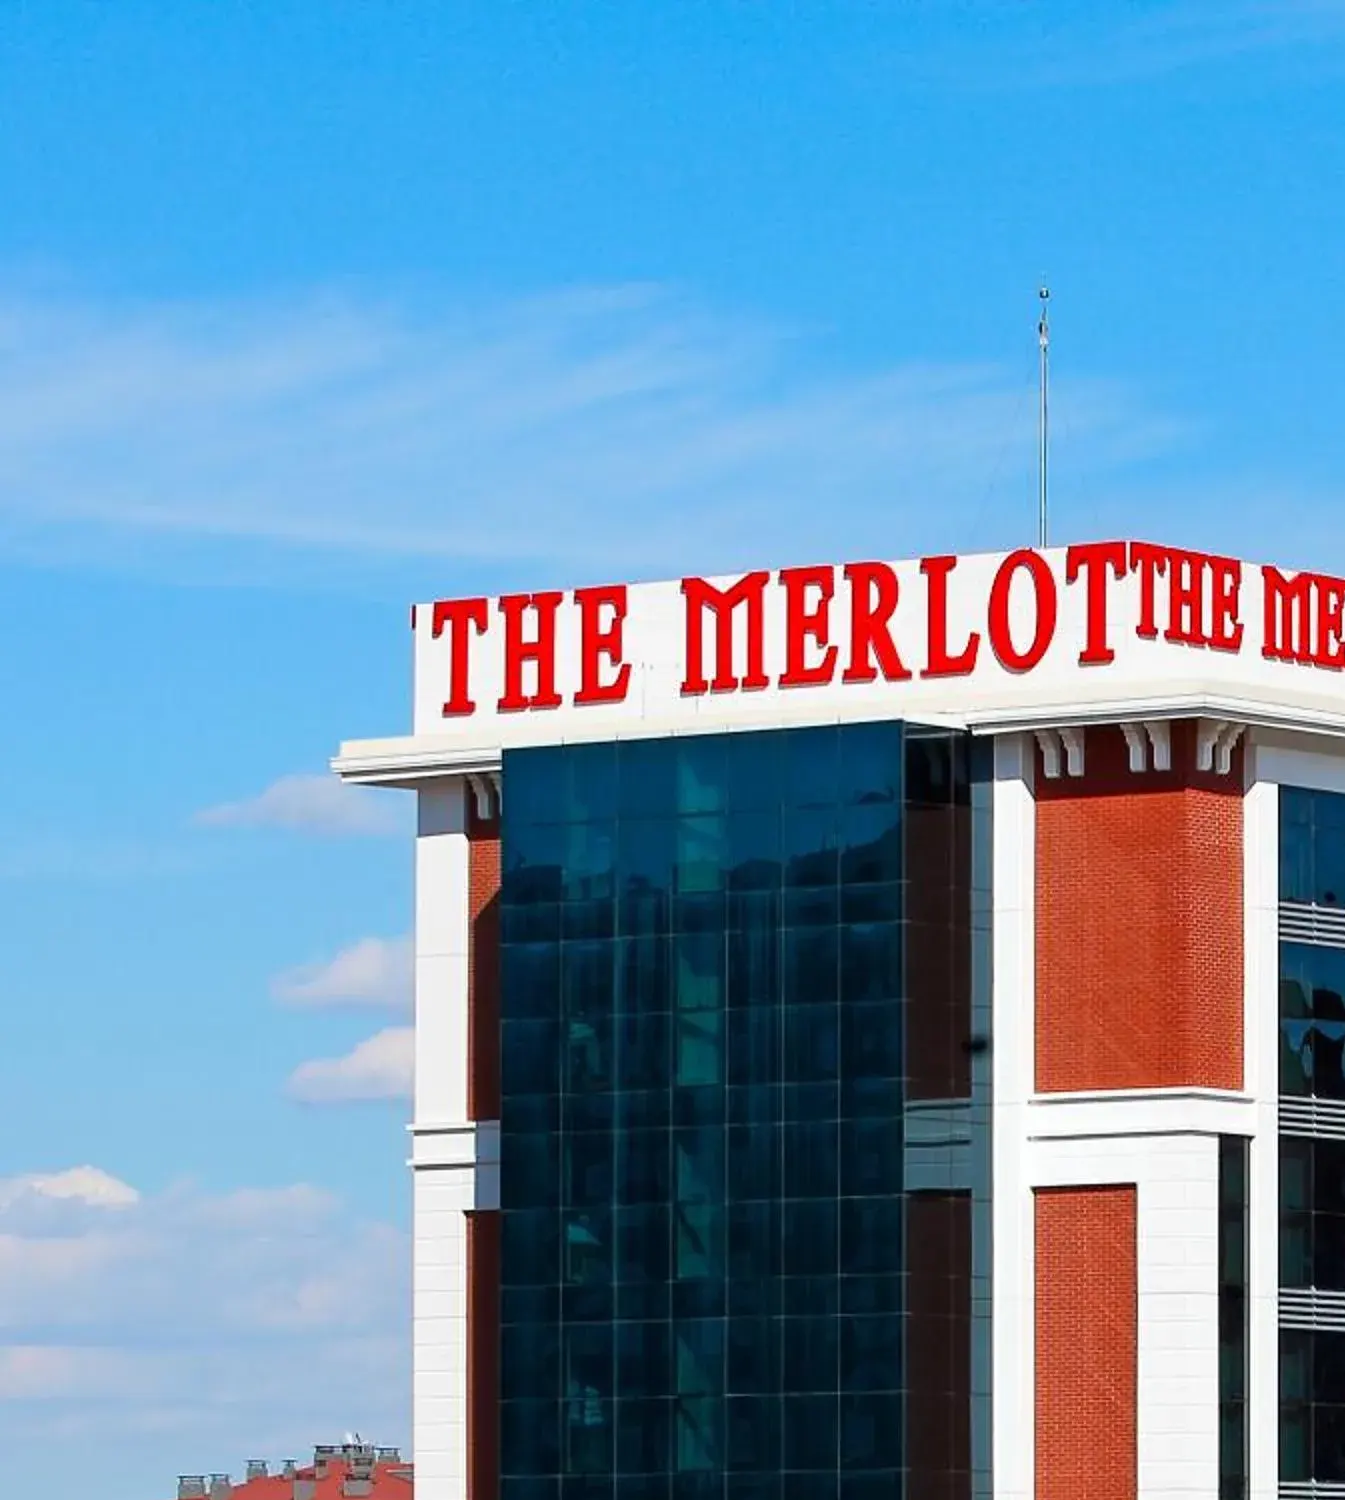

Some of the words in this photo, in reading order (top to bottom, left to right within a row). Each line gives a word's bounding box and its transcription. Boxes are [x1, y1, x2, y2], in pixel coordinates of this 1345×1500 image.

[432, 585, 632, 716] THE
[680, 542, 1128, 696] MERLOT
[1128, 541, 1244, 653] THE
